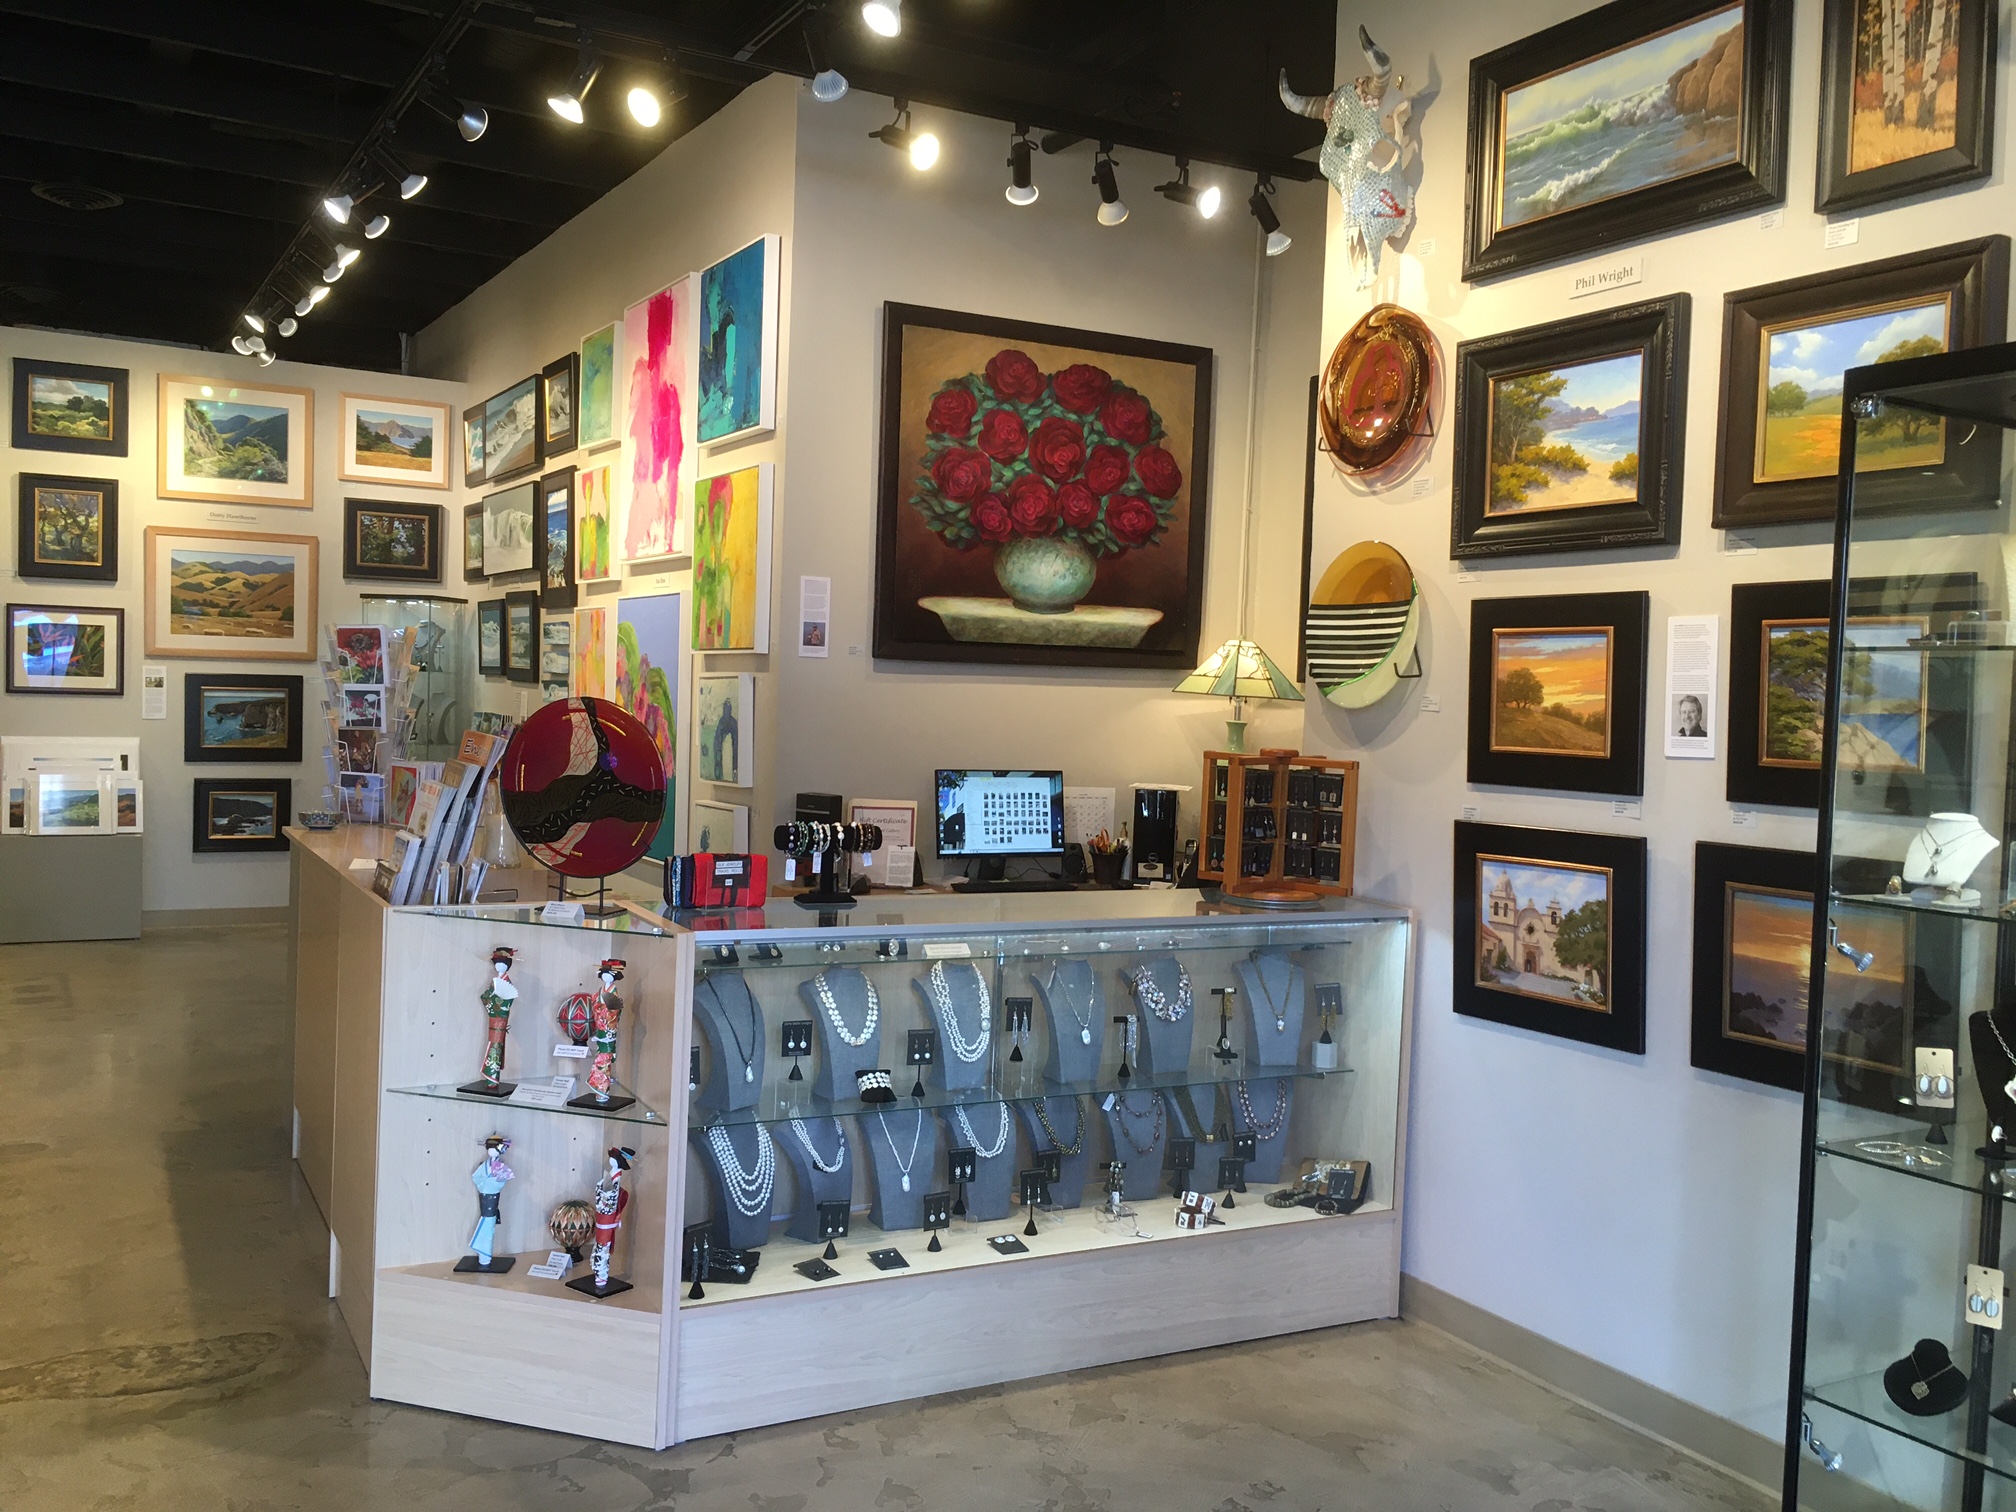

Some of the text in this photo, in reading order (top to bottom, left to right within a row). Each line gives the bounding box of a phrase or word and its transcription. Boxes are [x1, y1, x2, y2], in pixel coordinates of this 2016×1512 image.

[1575, 266, 1634, 290] Phil Wright
[873, 817, 909, 825] Certificate
